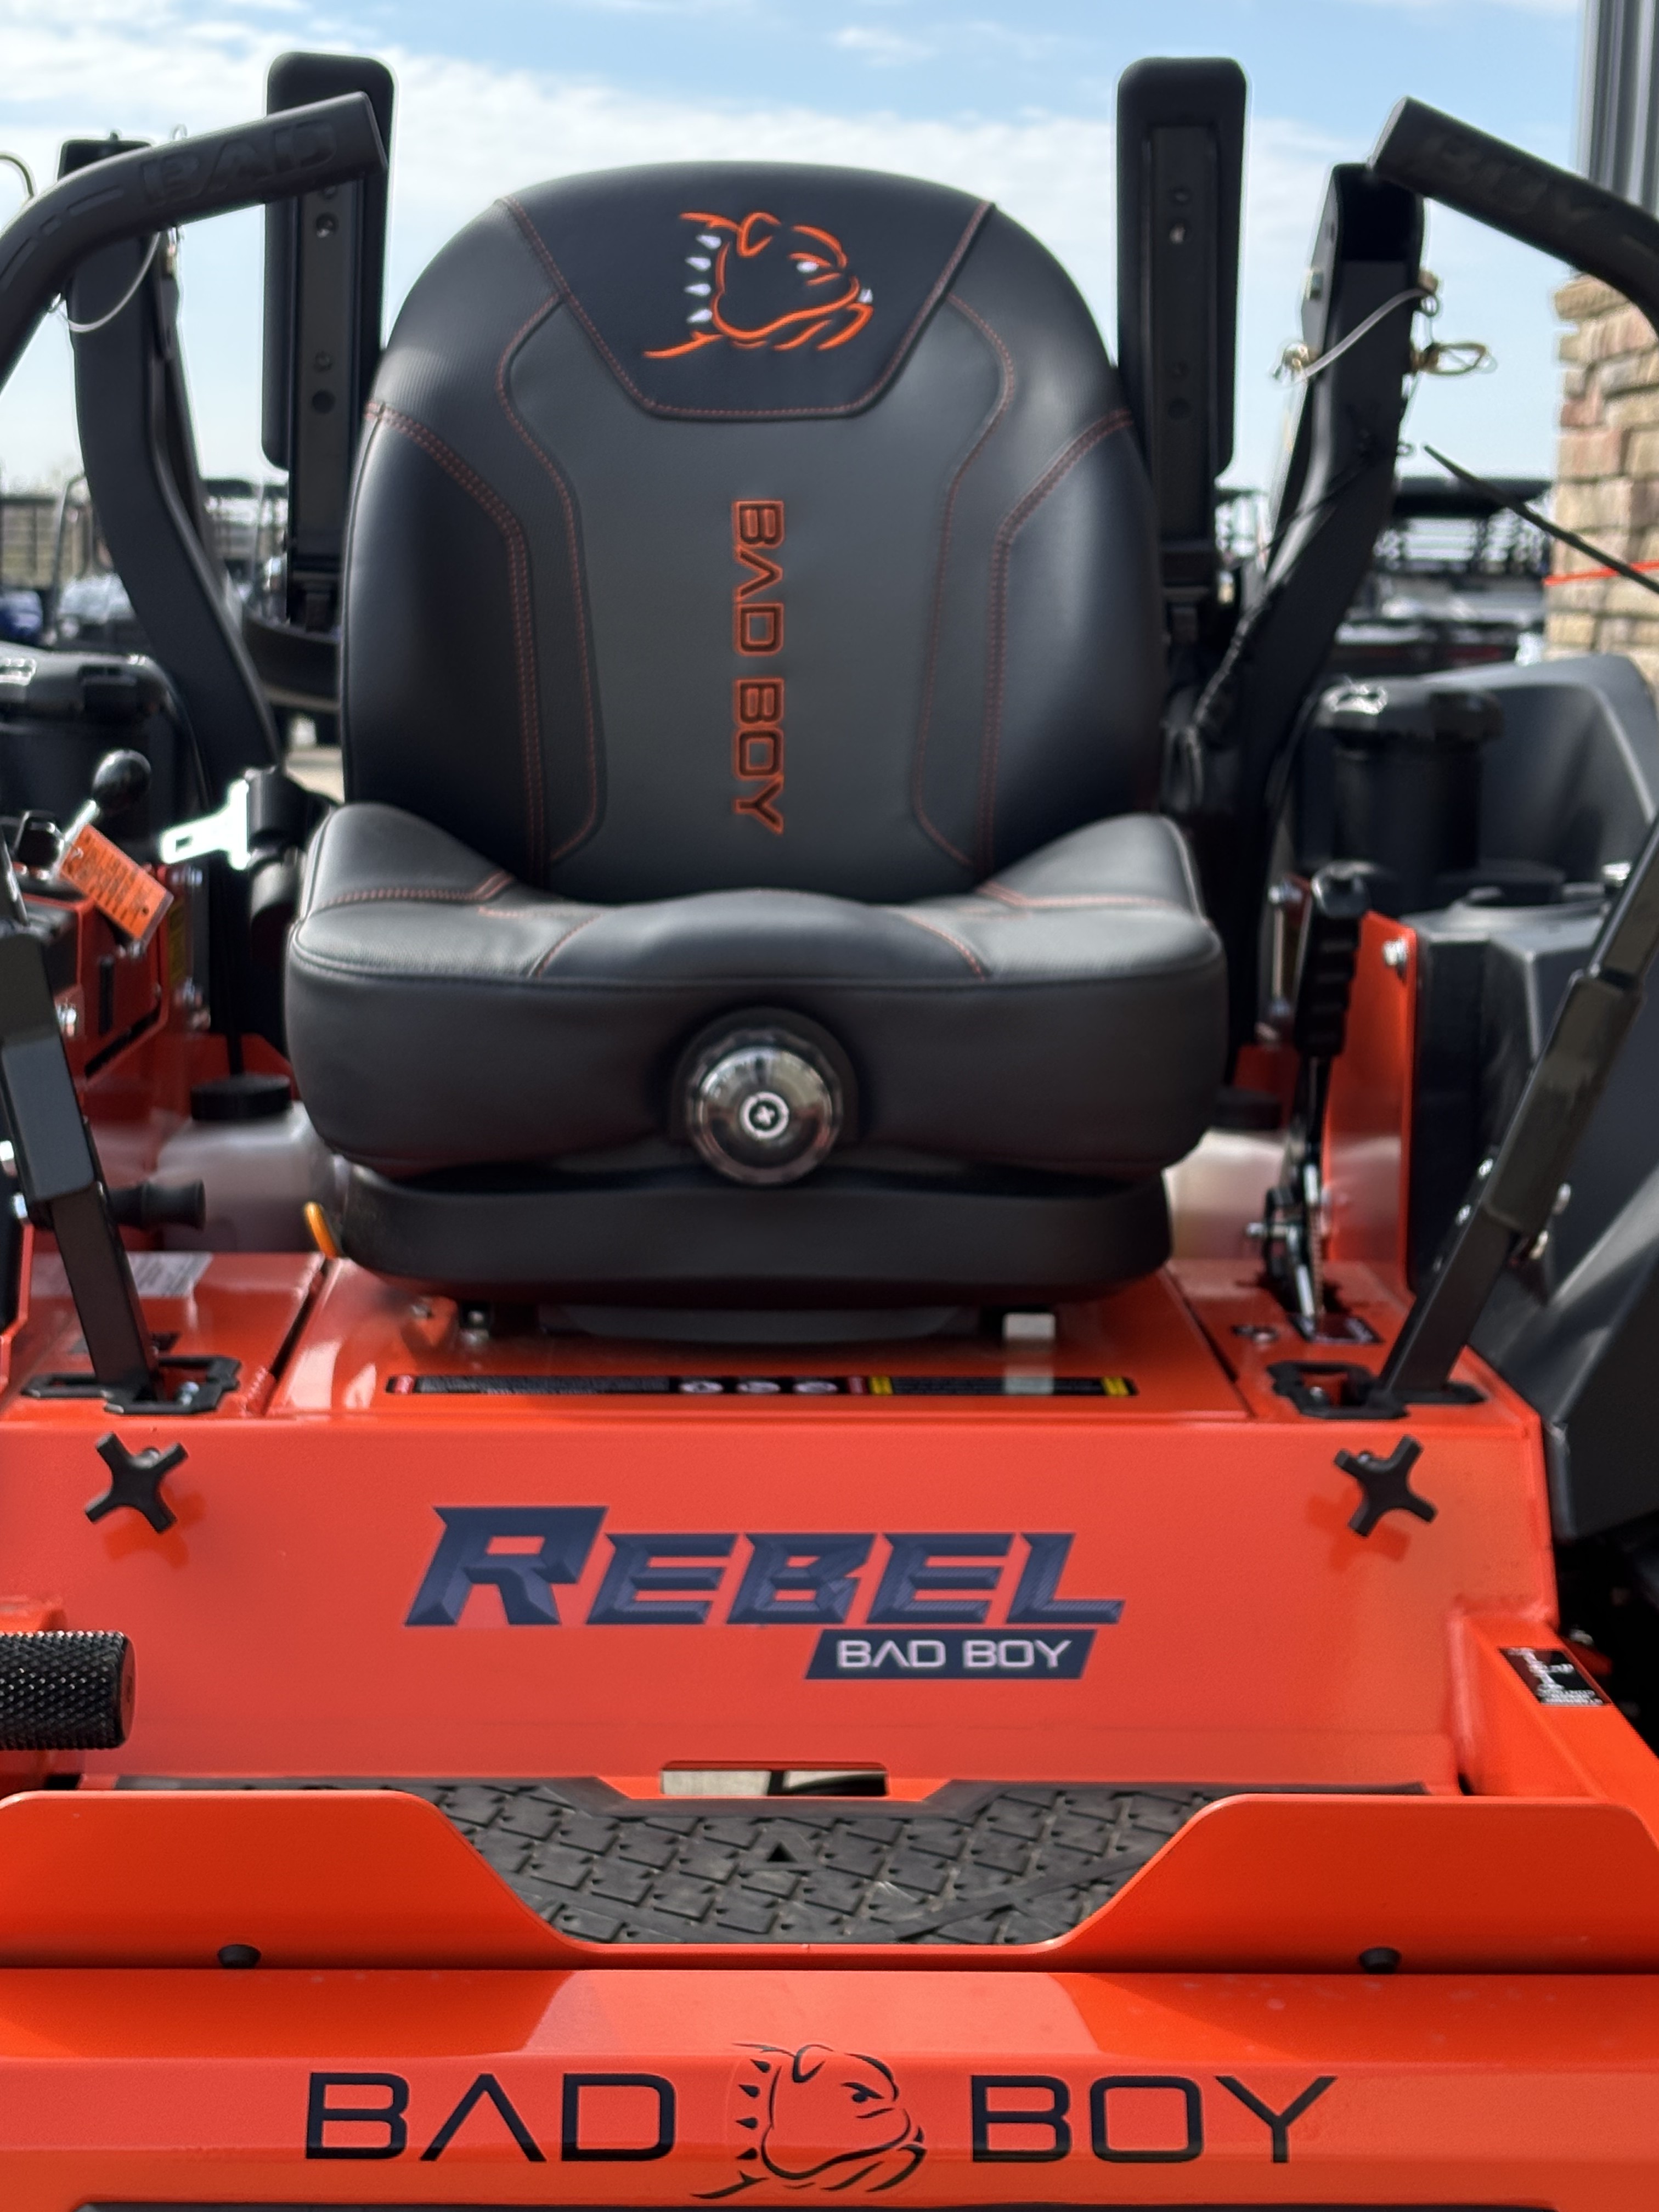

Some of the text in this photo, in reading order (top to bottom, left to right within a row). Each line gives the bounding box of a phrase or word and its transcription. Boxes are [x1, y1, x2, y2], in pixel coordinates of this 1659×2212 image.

[139, 118, 337, 208] BAD
[732, 501, 785, 836] BAD BOY
[405, 1505, 1125, 1626] REBEL
[837, 1639, 1073, 1668] BAD BOY
[305, 2072, 1338, 2164] BAD BOY
